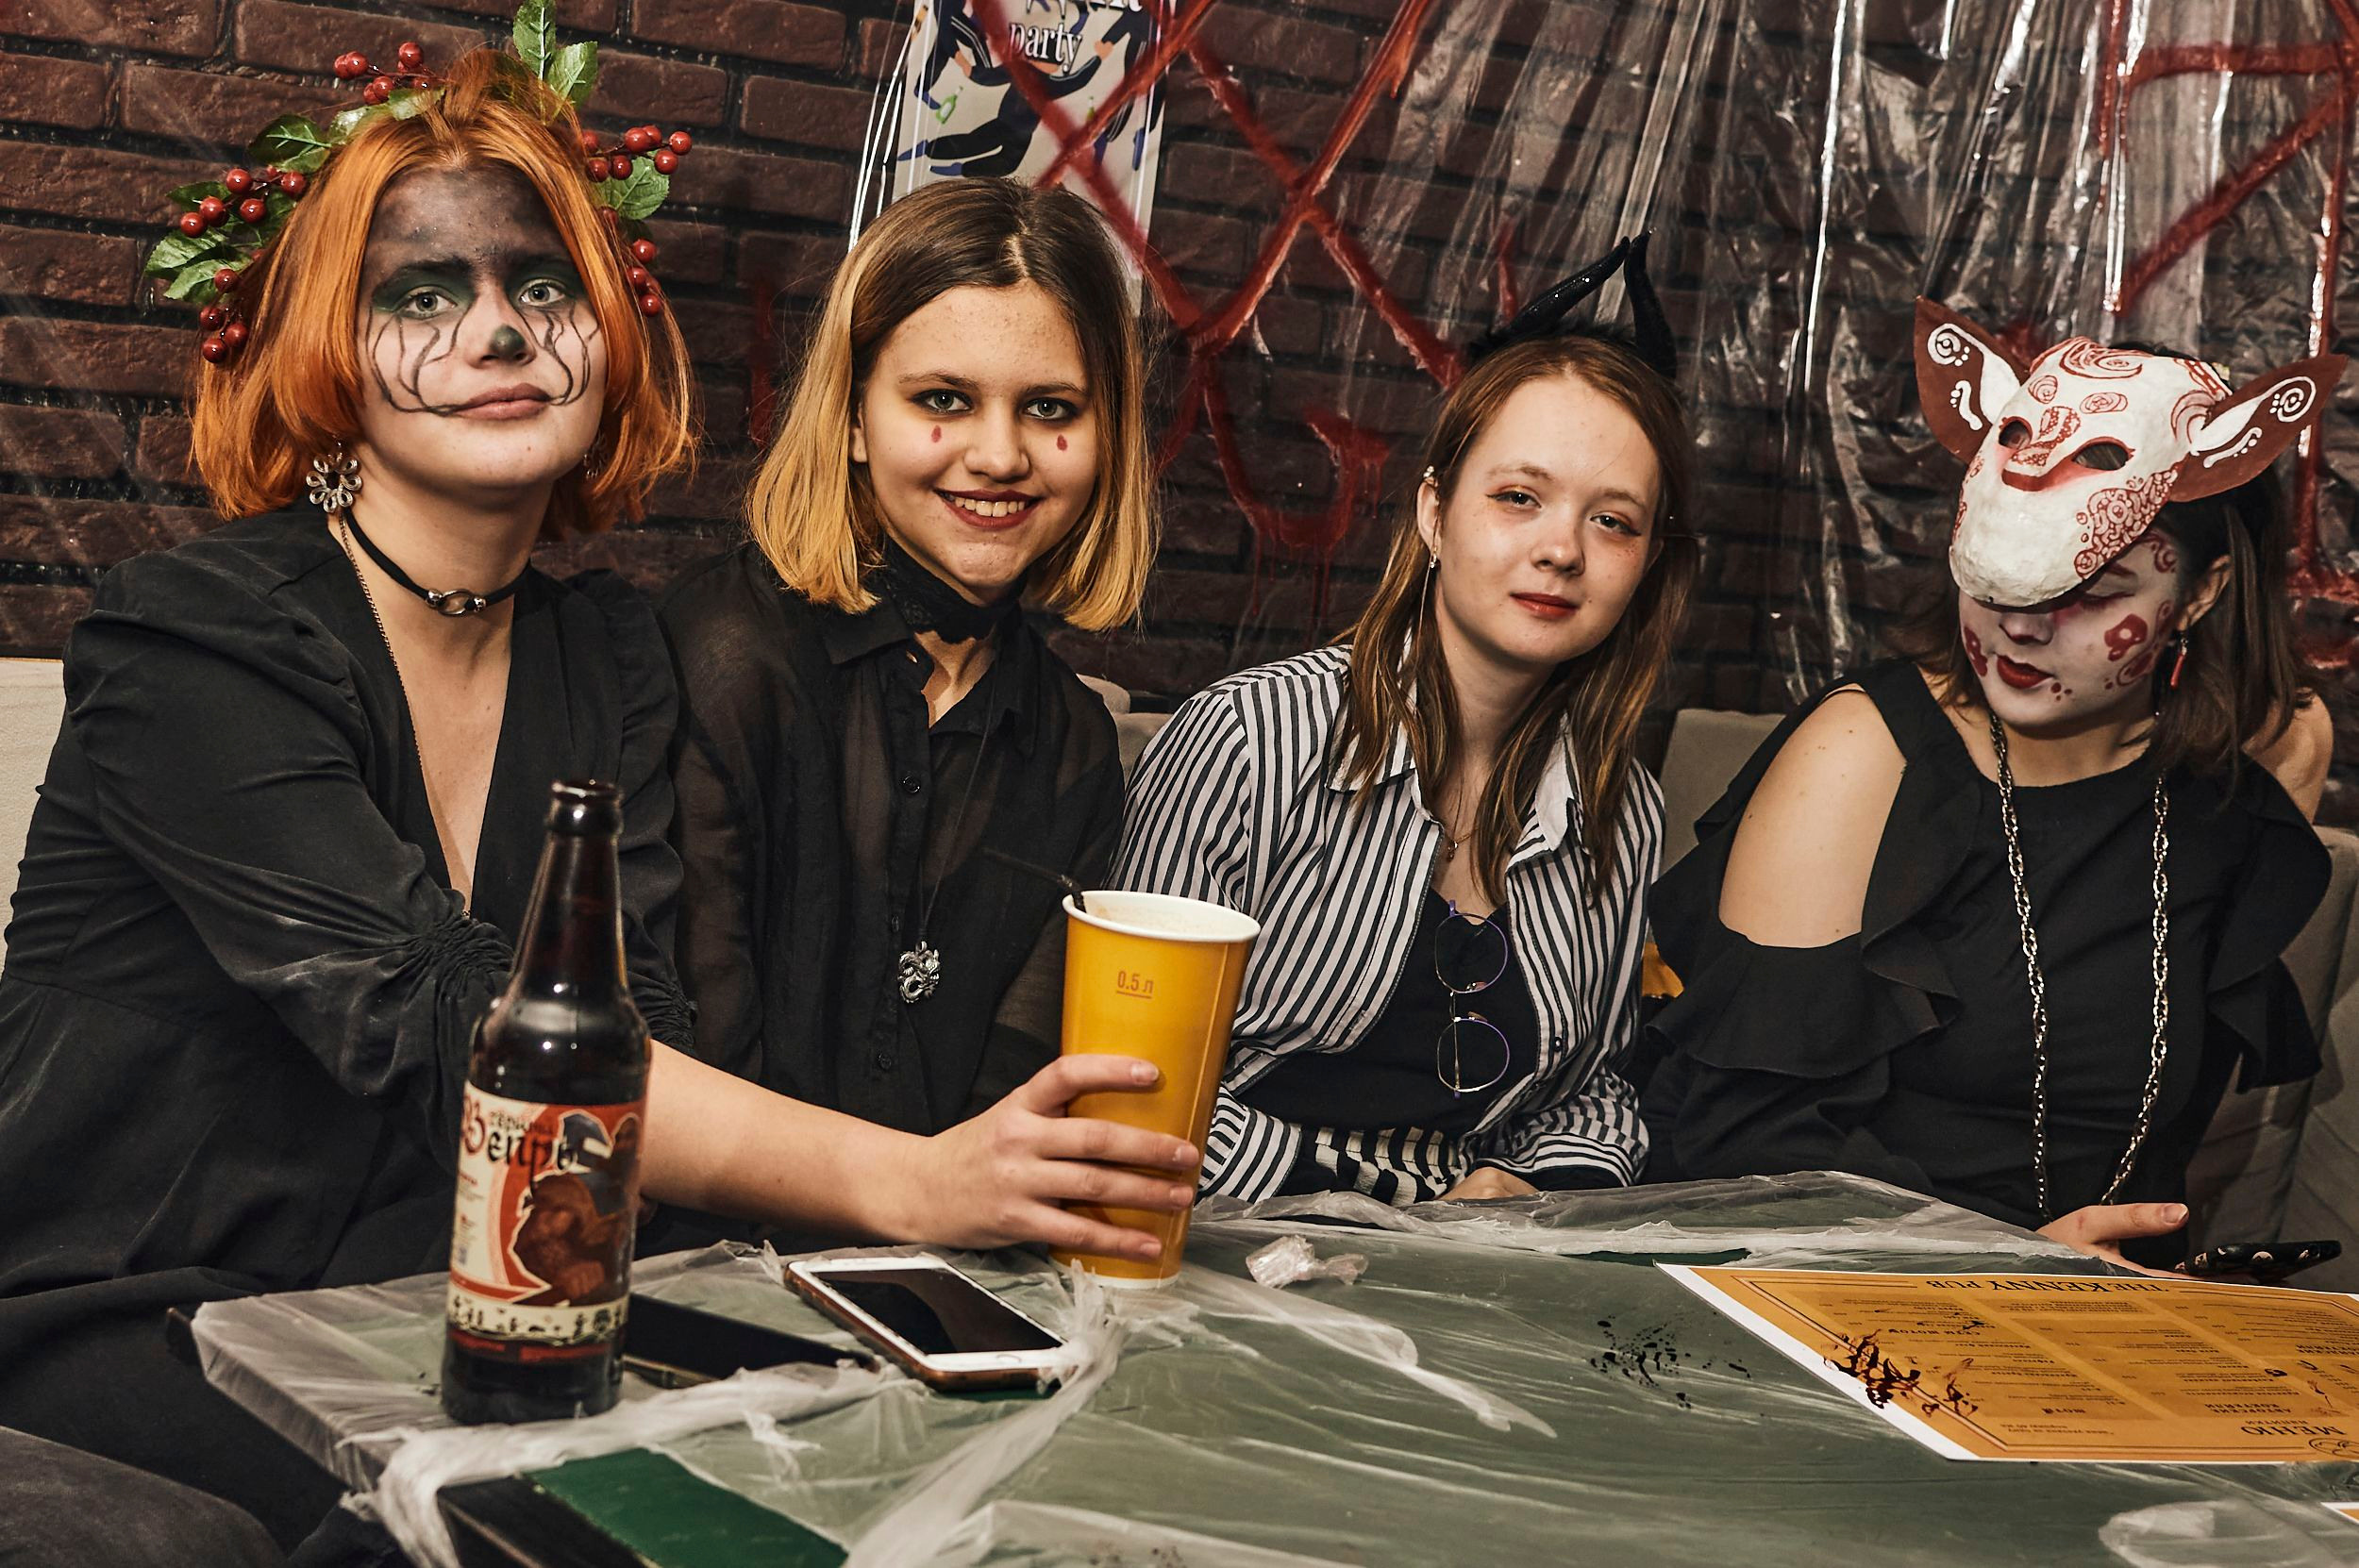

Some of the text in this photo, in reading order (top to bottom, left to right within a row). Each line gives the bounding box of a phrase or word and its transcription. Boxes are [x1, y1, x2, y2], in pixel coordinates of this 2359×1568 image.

[1008, 21, 1082, 75] party
[1117, 970, 1140, 992] 0.5
[1926, 1280, 2170, 1293] THE KENNY PUB
[2240, 1426, 2348, 1436] МЕНЮ
